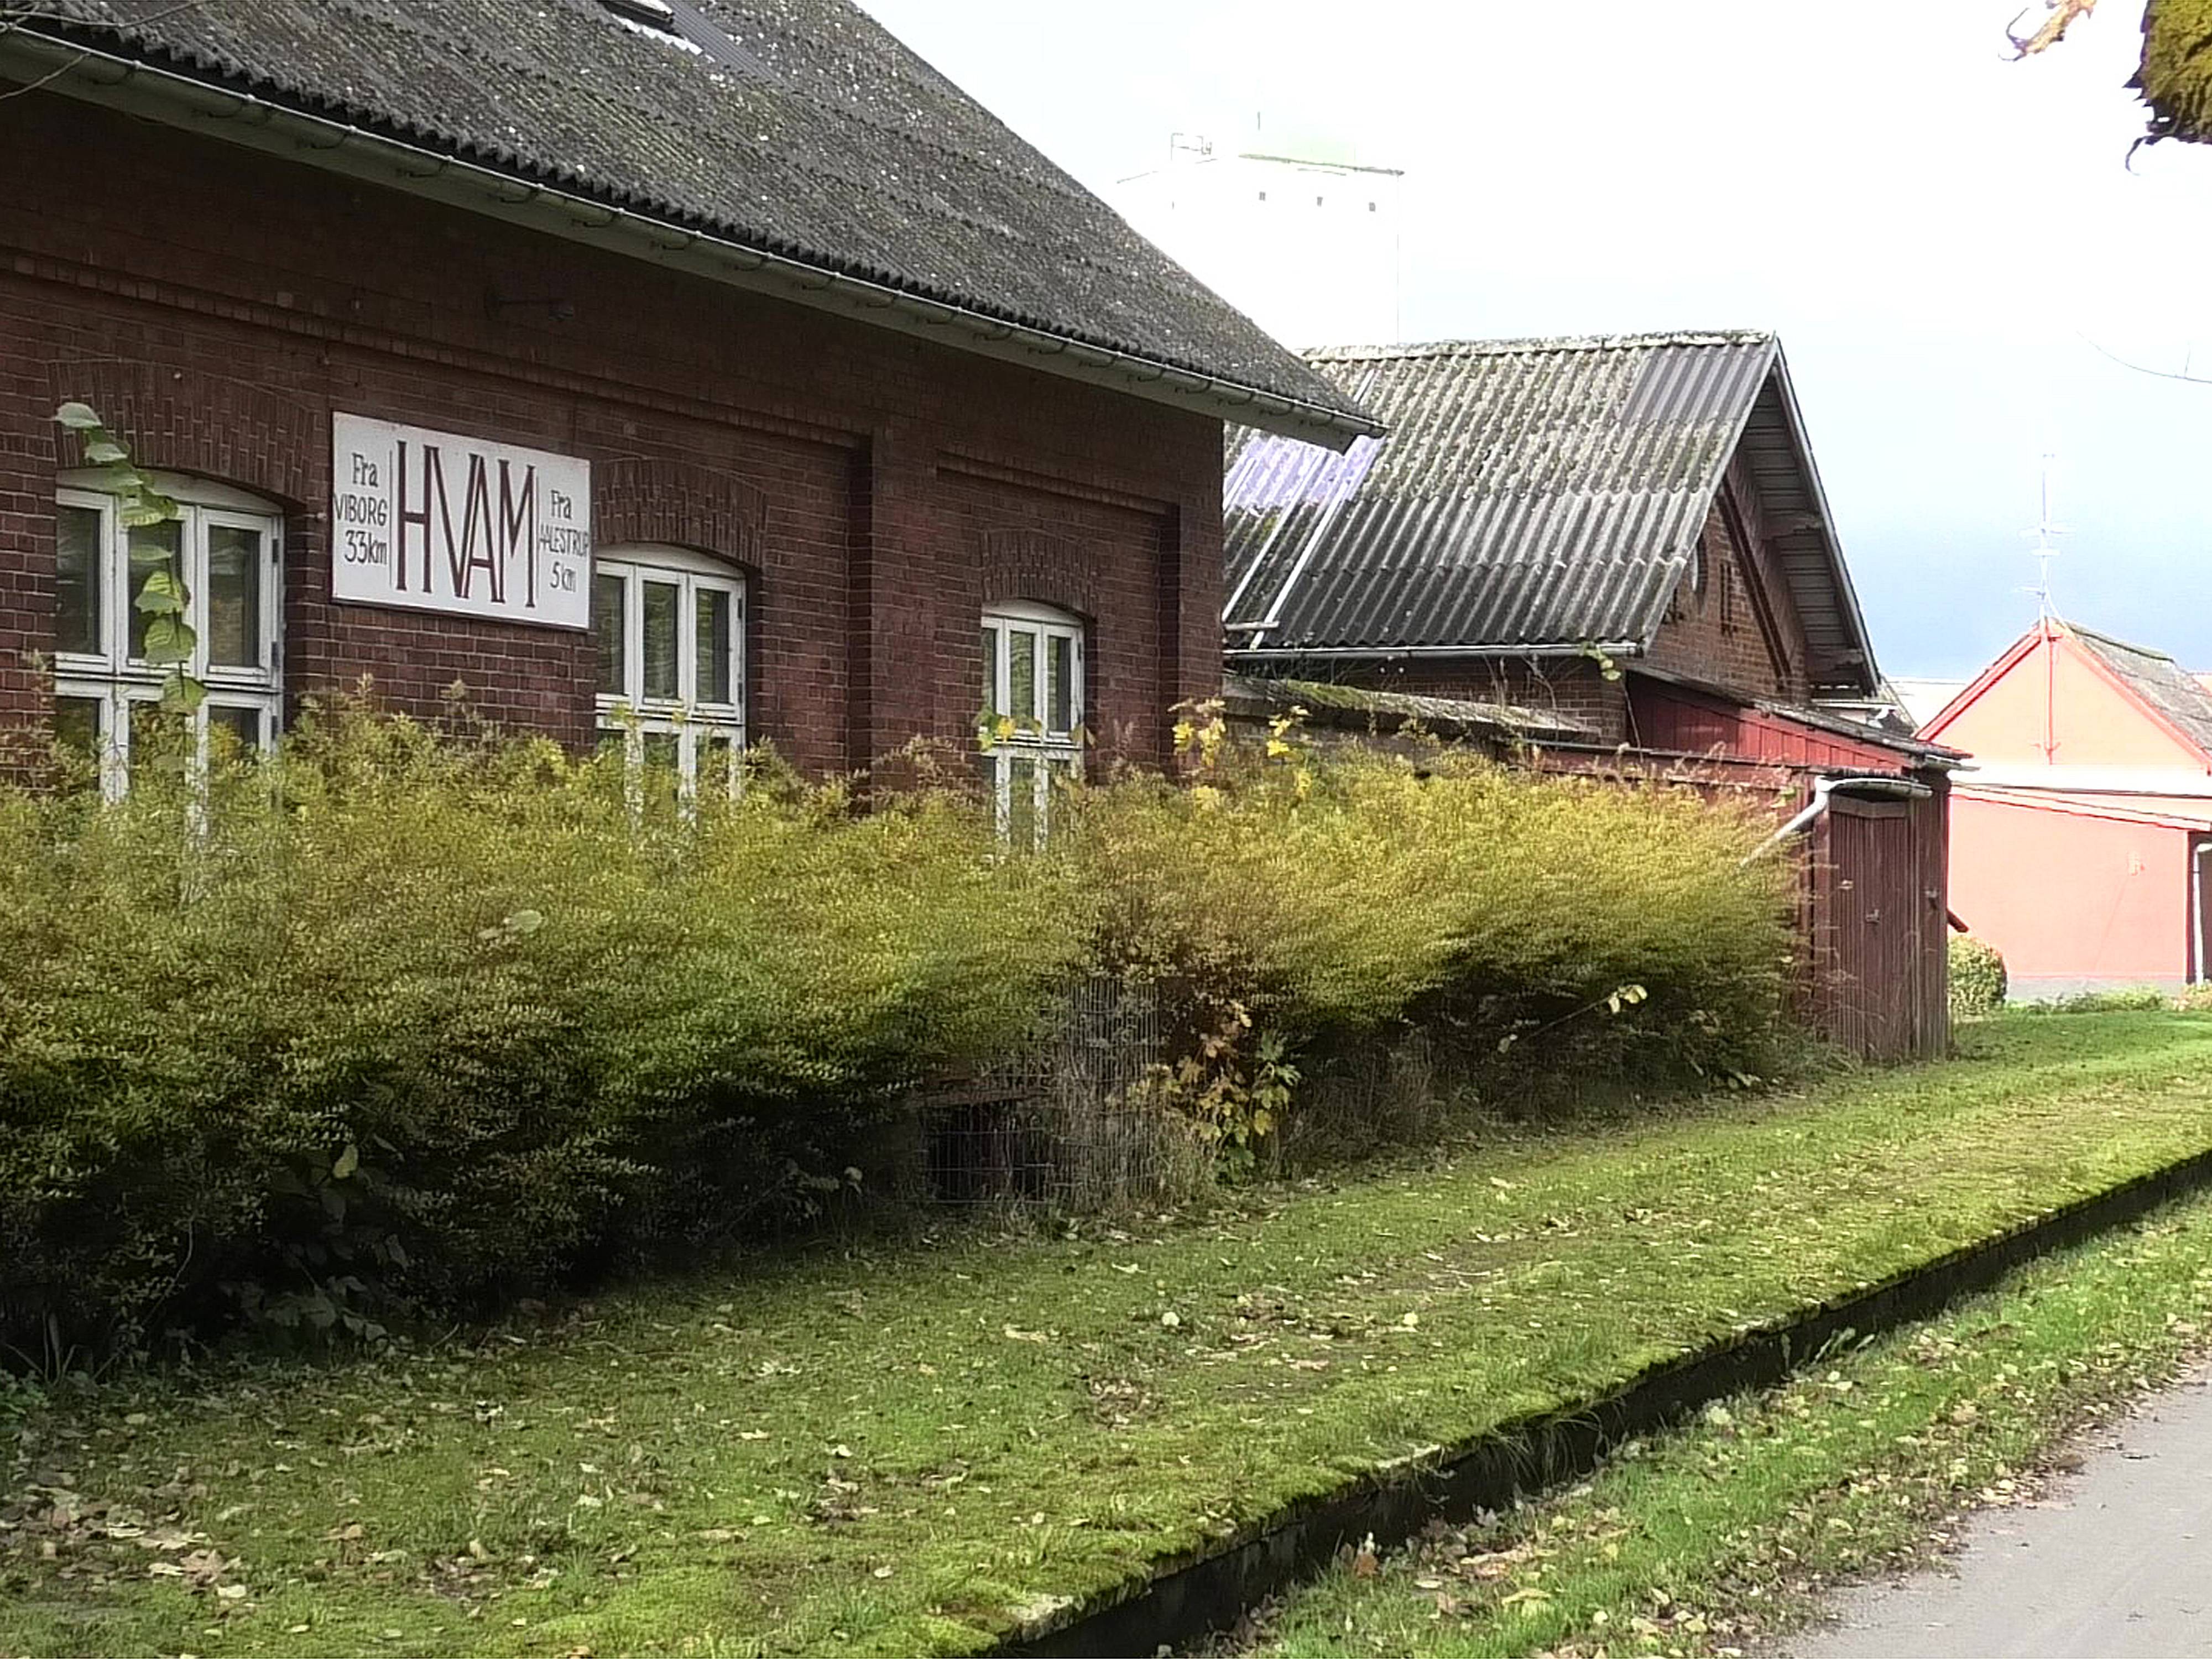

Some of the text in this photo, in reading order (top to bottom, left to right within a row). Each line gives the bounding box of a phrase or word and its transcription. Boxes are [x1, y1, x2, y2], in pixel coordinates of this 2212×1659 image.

[352, 452, 379, 488] Fra
[333, 493, 387, 526] VIBORG
[551, 489, 572, 520] Fra
[397, 440, 535, 608] HVAM
